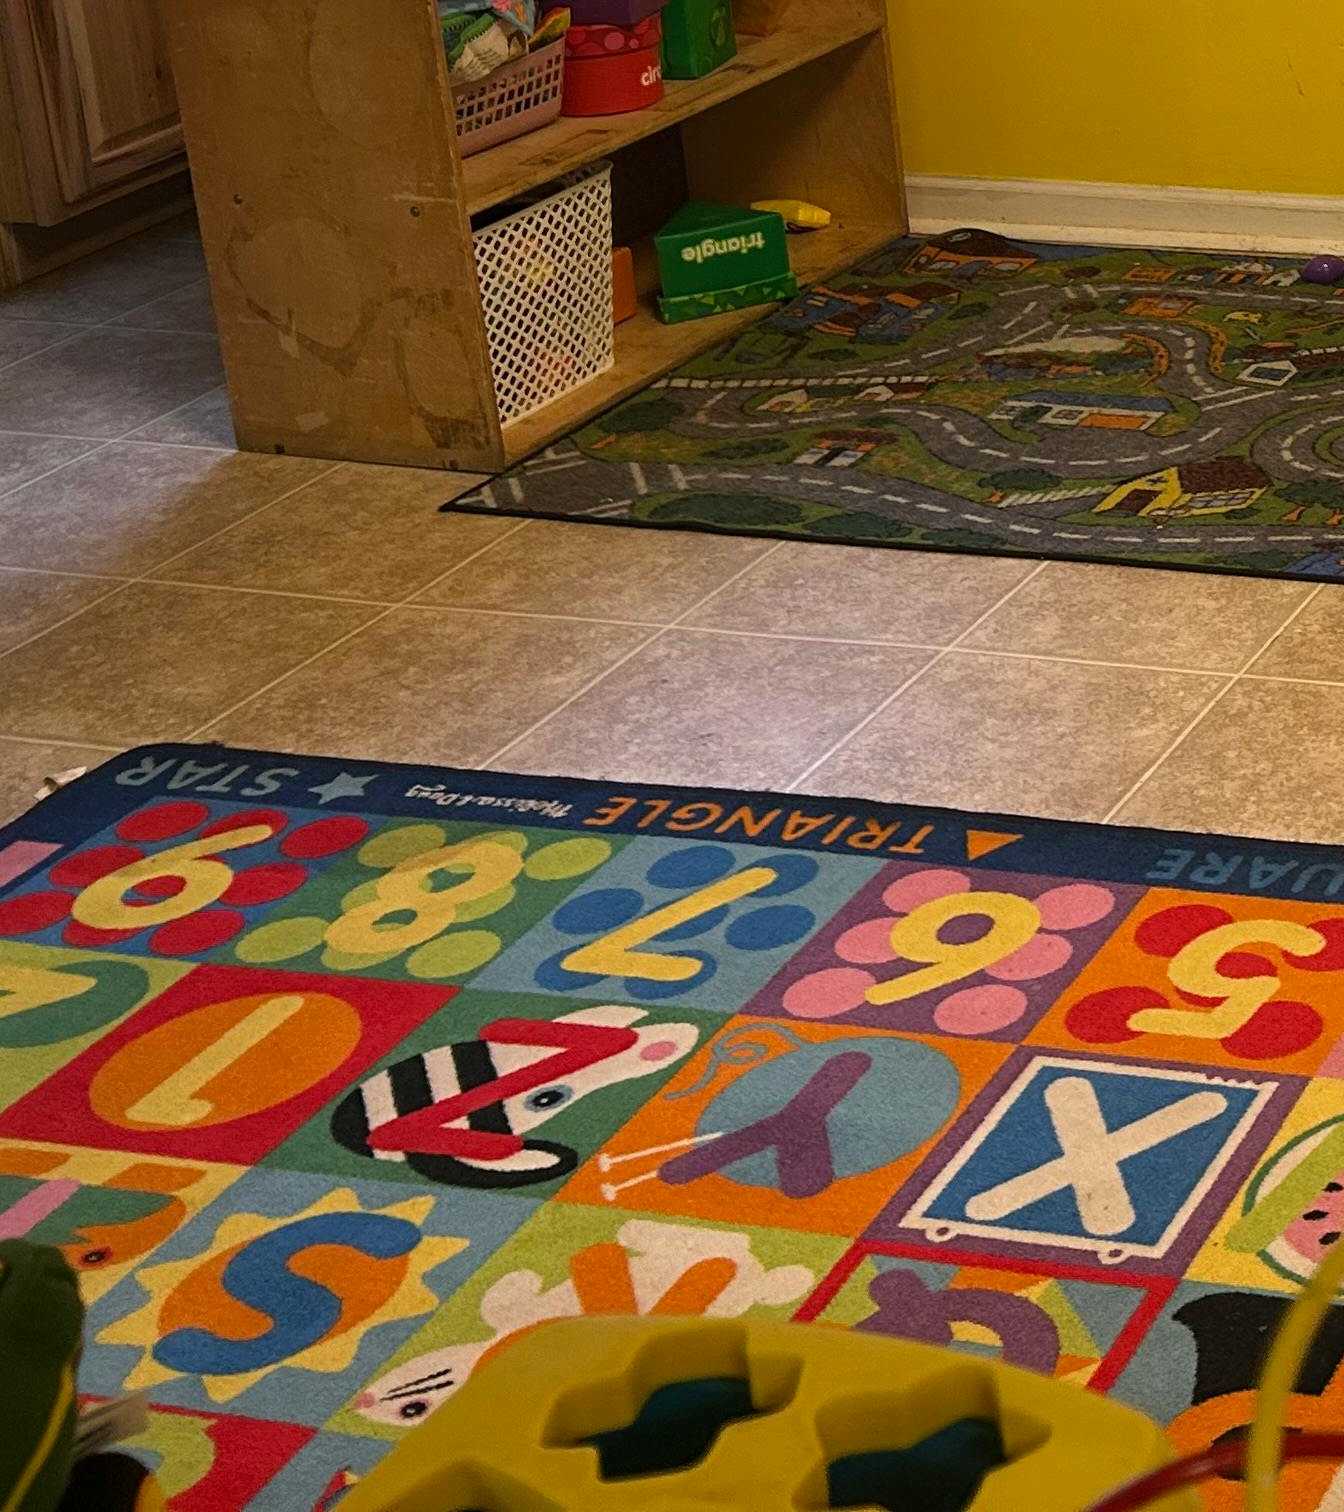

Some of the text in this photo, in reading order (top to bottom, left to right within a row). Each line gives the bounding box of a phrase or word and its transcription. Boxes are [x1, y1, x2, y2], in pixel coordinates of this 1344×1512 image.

[681, 231, 765, 263] triangle
[115, 755, 300, 797] STAR
[584, 795, 935, 860] TRIANGLE
[326, 840, 524, 958] 8
[559, 866, 776, 981] 7
[1128, 918, 1327, 1039] 5
[125, 995, 307, 1128] 1
[367, 1016, 639, 1160] Z
[657, 1050, 872, 1199] Y
[964, 1074, 1227, 1235] X
[152, 1210, 424, 1375] S
